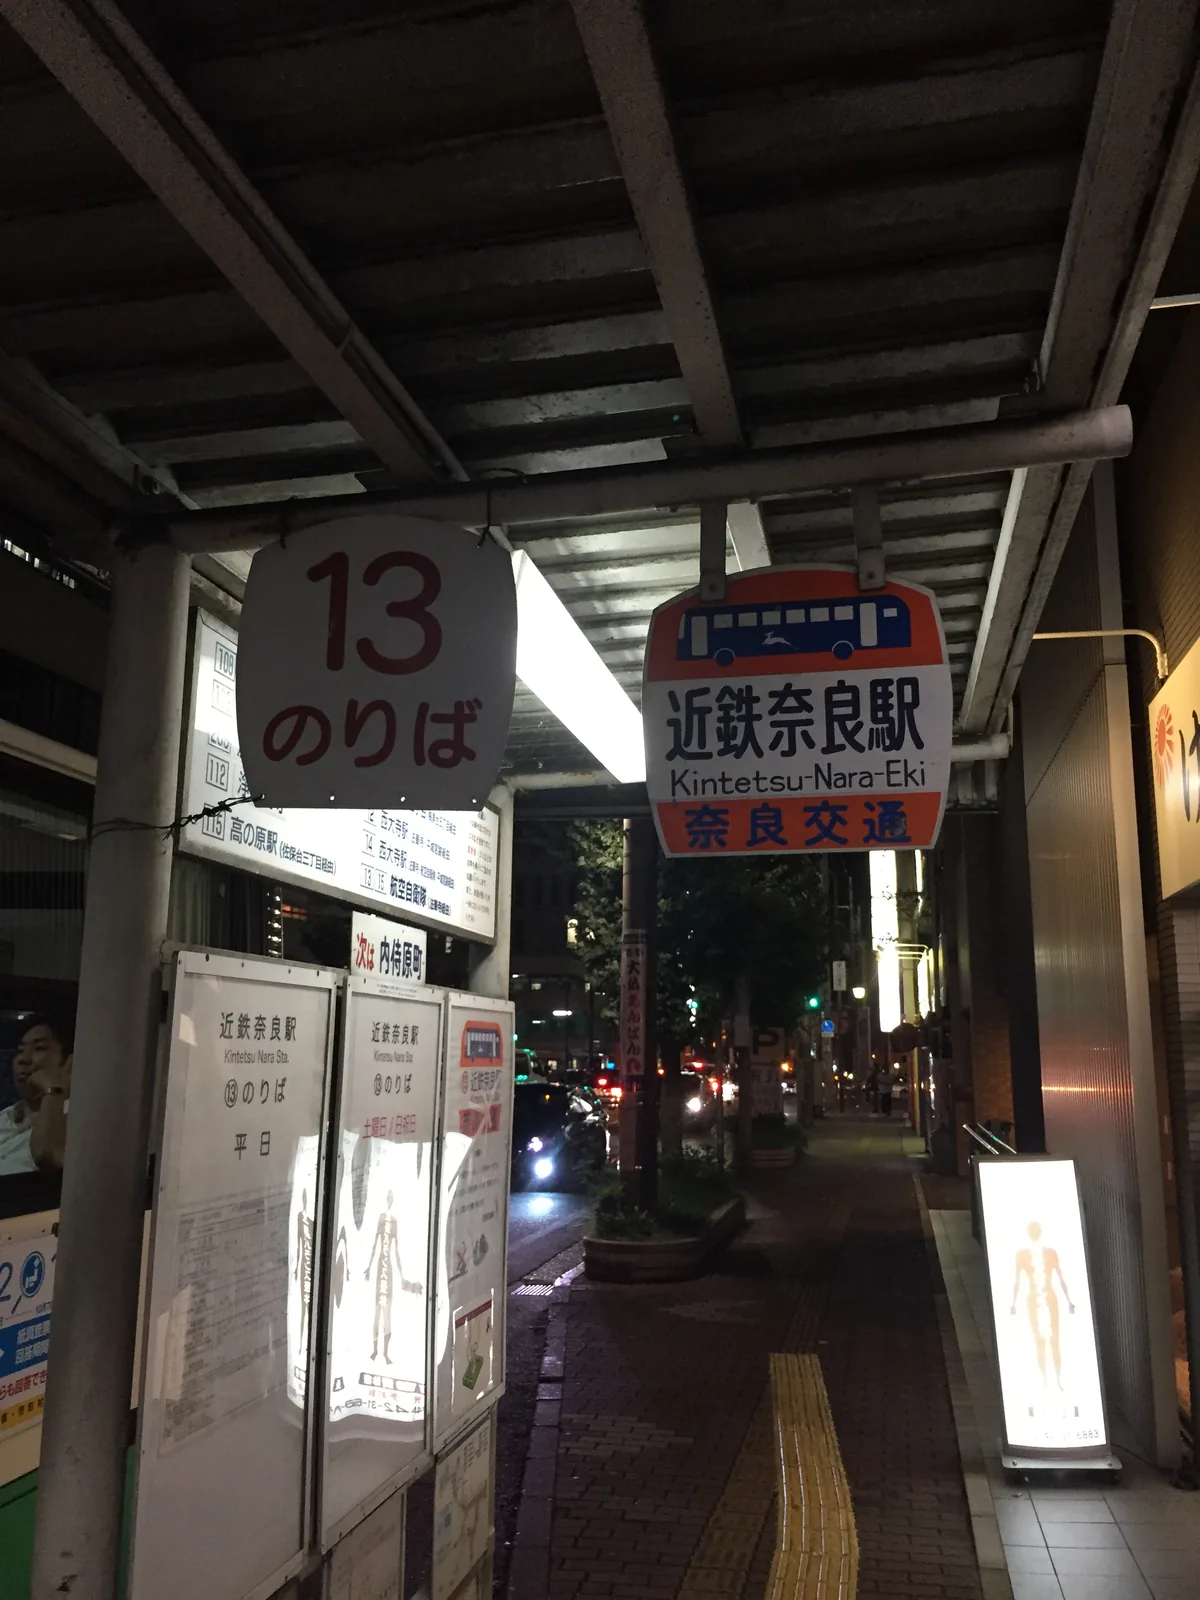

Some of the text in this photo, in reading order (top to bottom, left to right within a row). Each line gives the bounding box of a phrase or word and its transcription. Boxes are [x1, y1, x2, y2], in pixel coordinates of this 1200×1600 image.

[305, 549, 443, 676] 13
[262, 697, 483, 769] のりば
[665, 676, 924, 761] 近鉄奈良駅
[209, 758, 227, 787] 112
[671, 760, 926, 797] Kintetsu-Nara-Eki
[229, 816, 279, 856] 高の原駅
[684, 800, 911, 849] 奈良交通
[355, 932, 375, 971] 次は
[219, 1012, 297, 1042] 近鉄奈良駅
[371, 1021, 419, 1046] 近鉄奈良駅
[224, 1049, 255, 1064] Kintetsu
[257, 1050, 275, 1064] Nara
